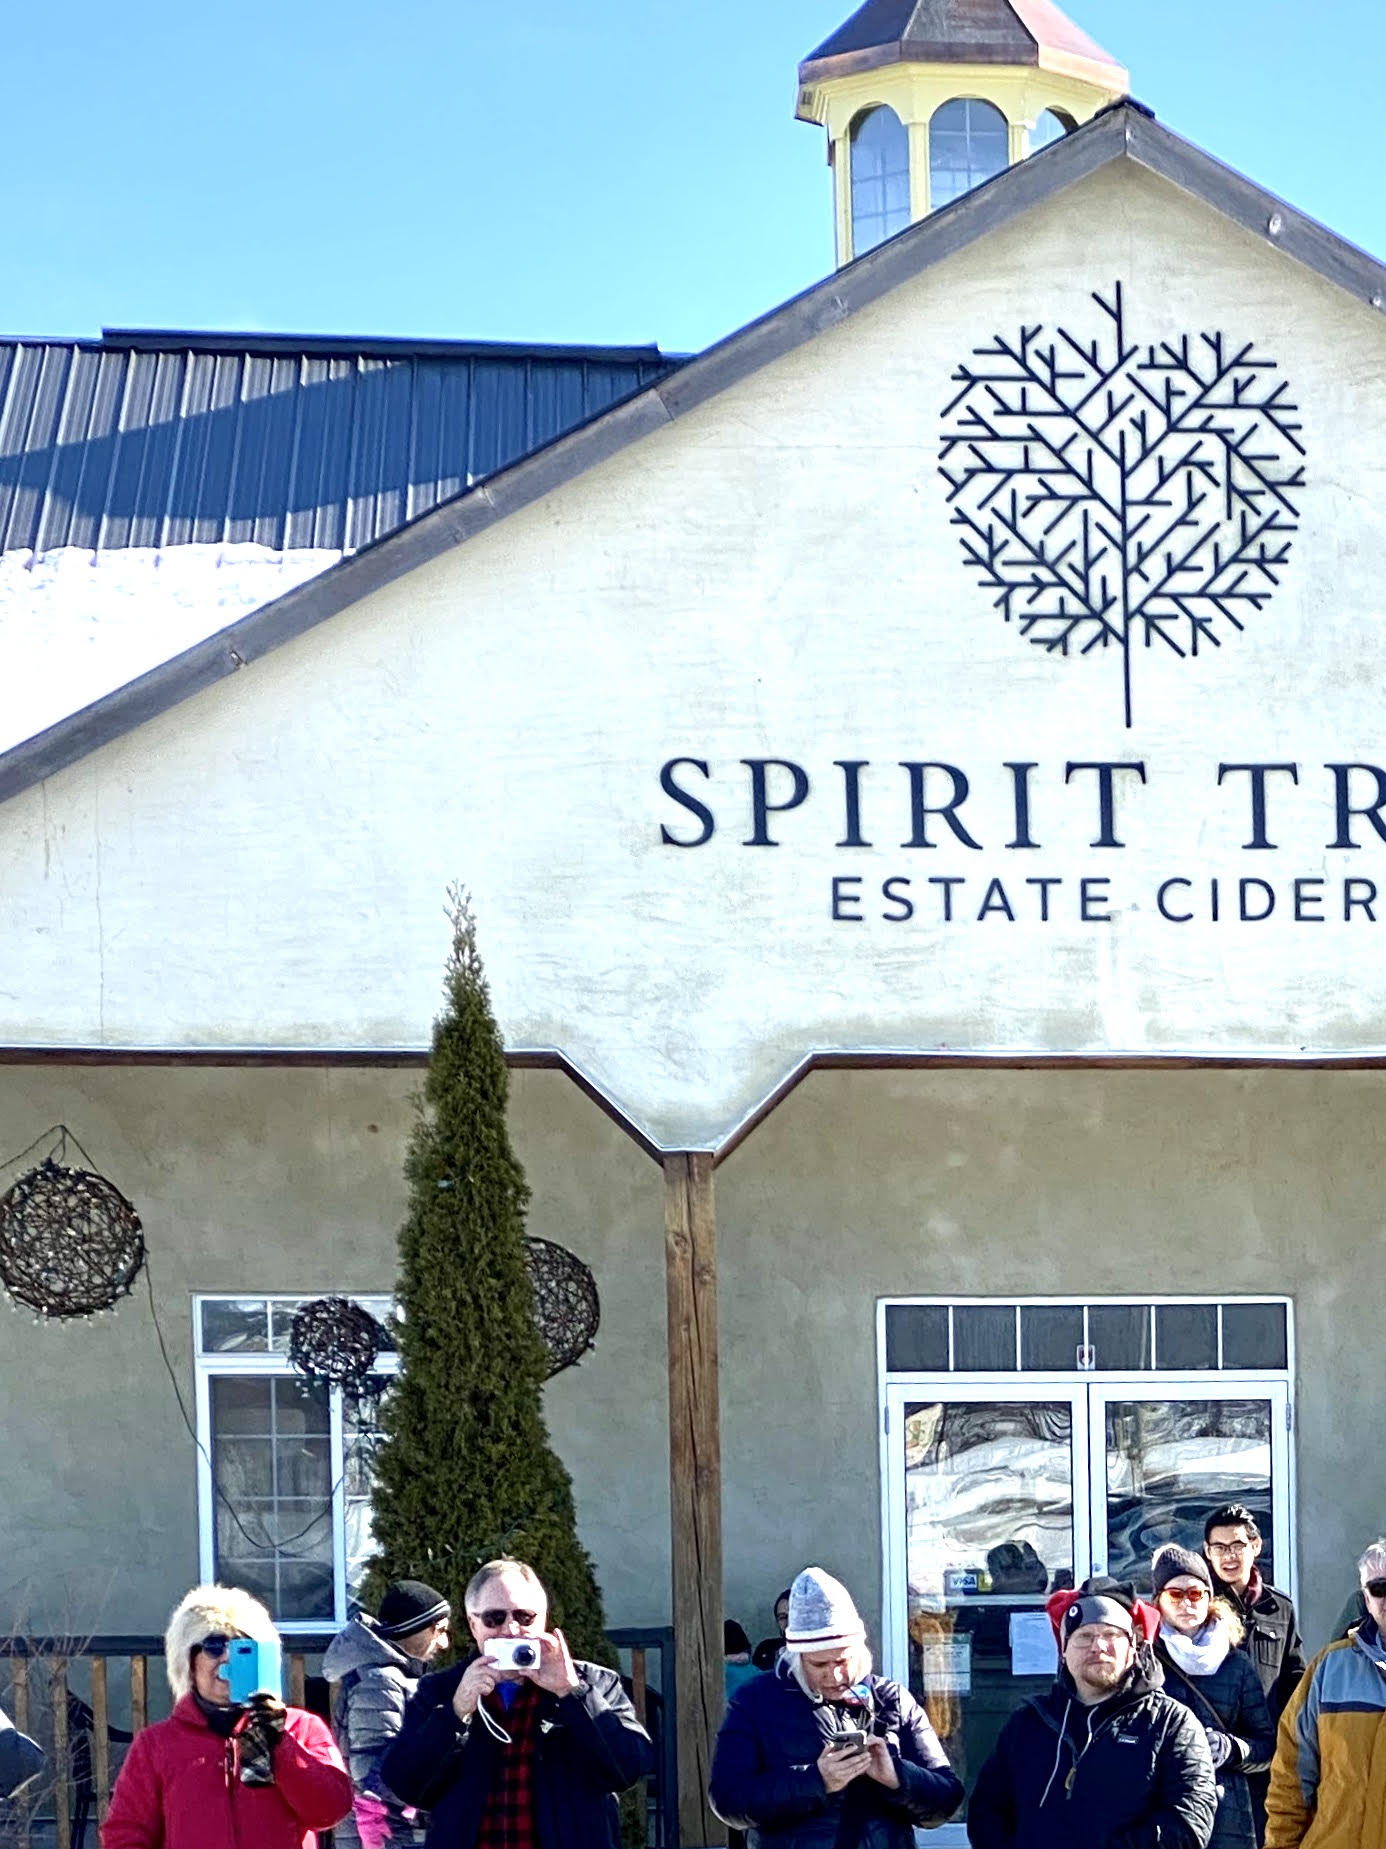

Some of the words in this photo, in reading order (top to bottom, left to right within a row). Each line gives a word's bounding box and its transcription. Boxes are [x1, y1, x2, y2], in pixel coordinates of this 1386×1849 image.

[659, 757, 1147, 851] SPIRIT
[832, 876, 1112, 922] ESTATE
[951, 1576, 976, 1585] VISA
